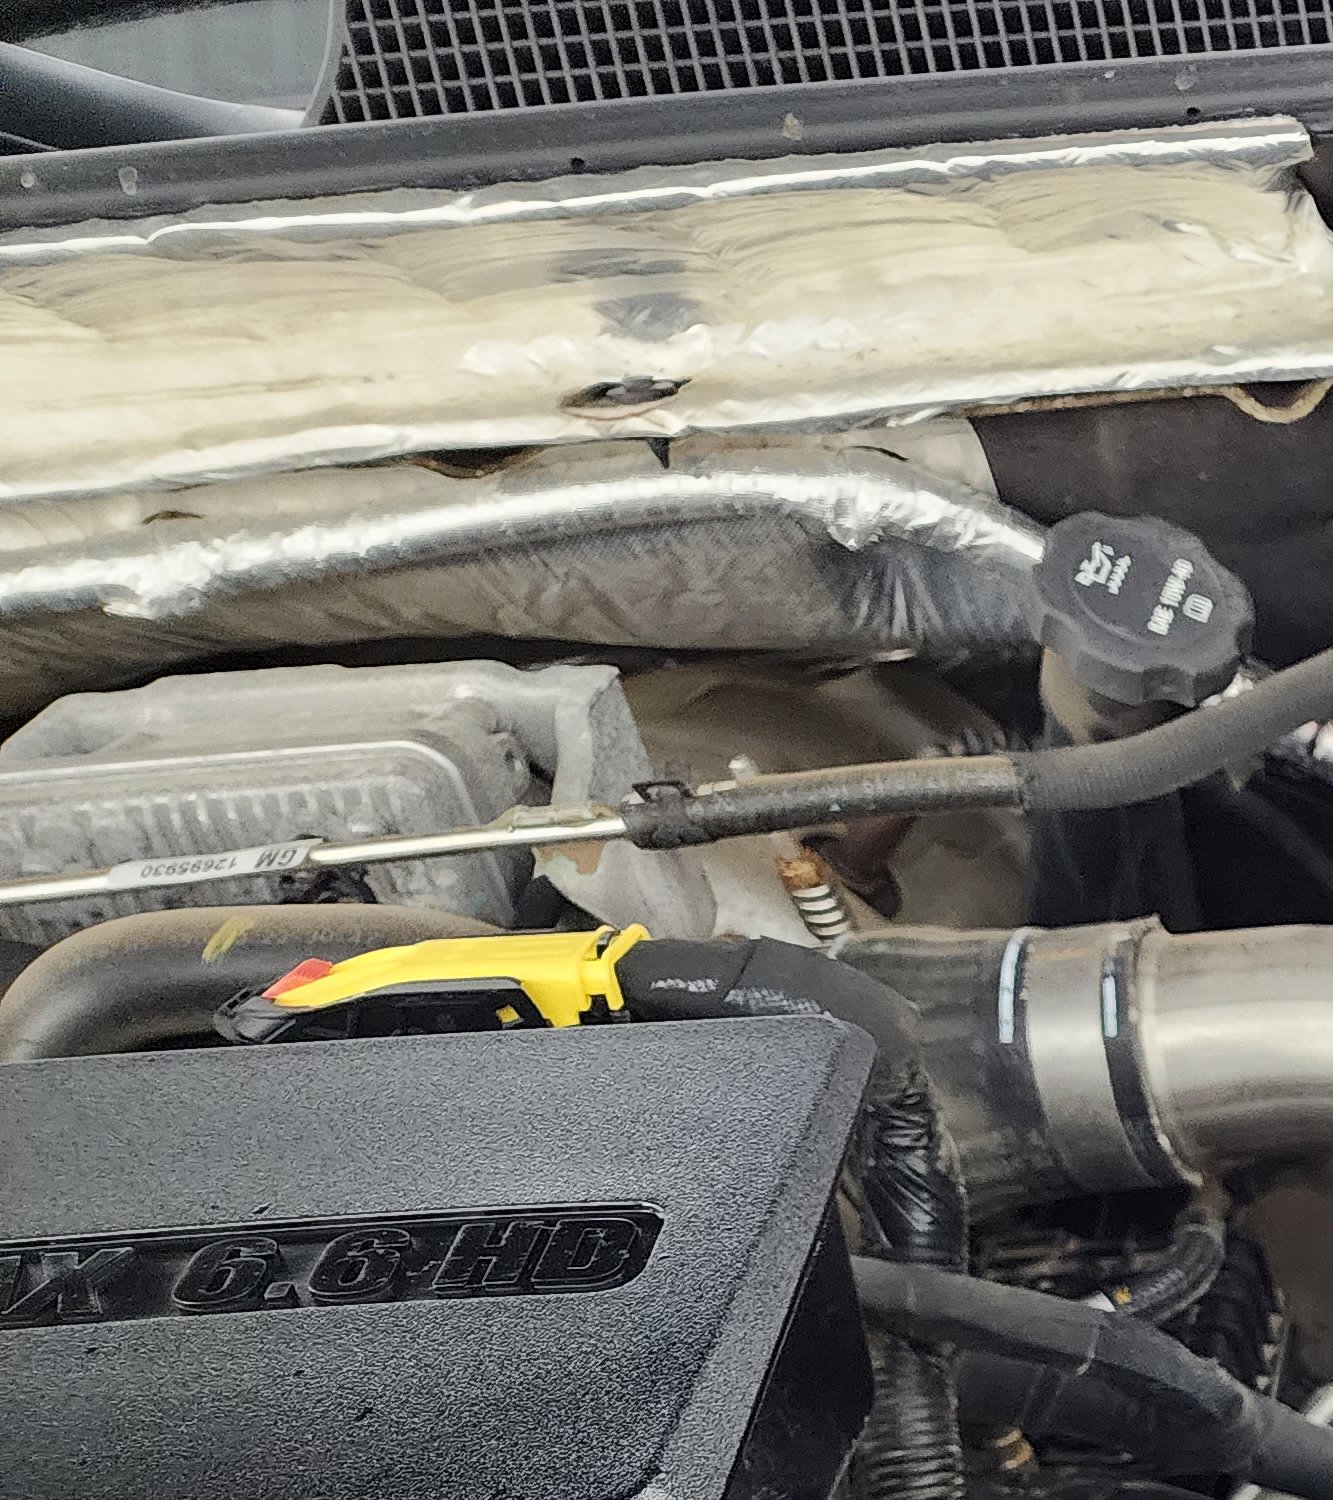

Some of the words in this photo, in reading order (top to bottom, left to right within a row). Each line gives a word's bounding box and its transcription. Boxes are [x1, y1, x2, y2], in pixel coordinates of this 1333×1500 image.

[255, 849, 297, 868] GM
[0, 1246, 133, 1321] X
[171, 1228, 410, 1309] 6.6
[432, 1217, 642, 1296] HD
